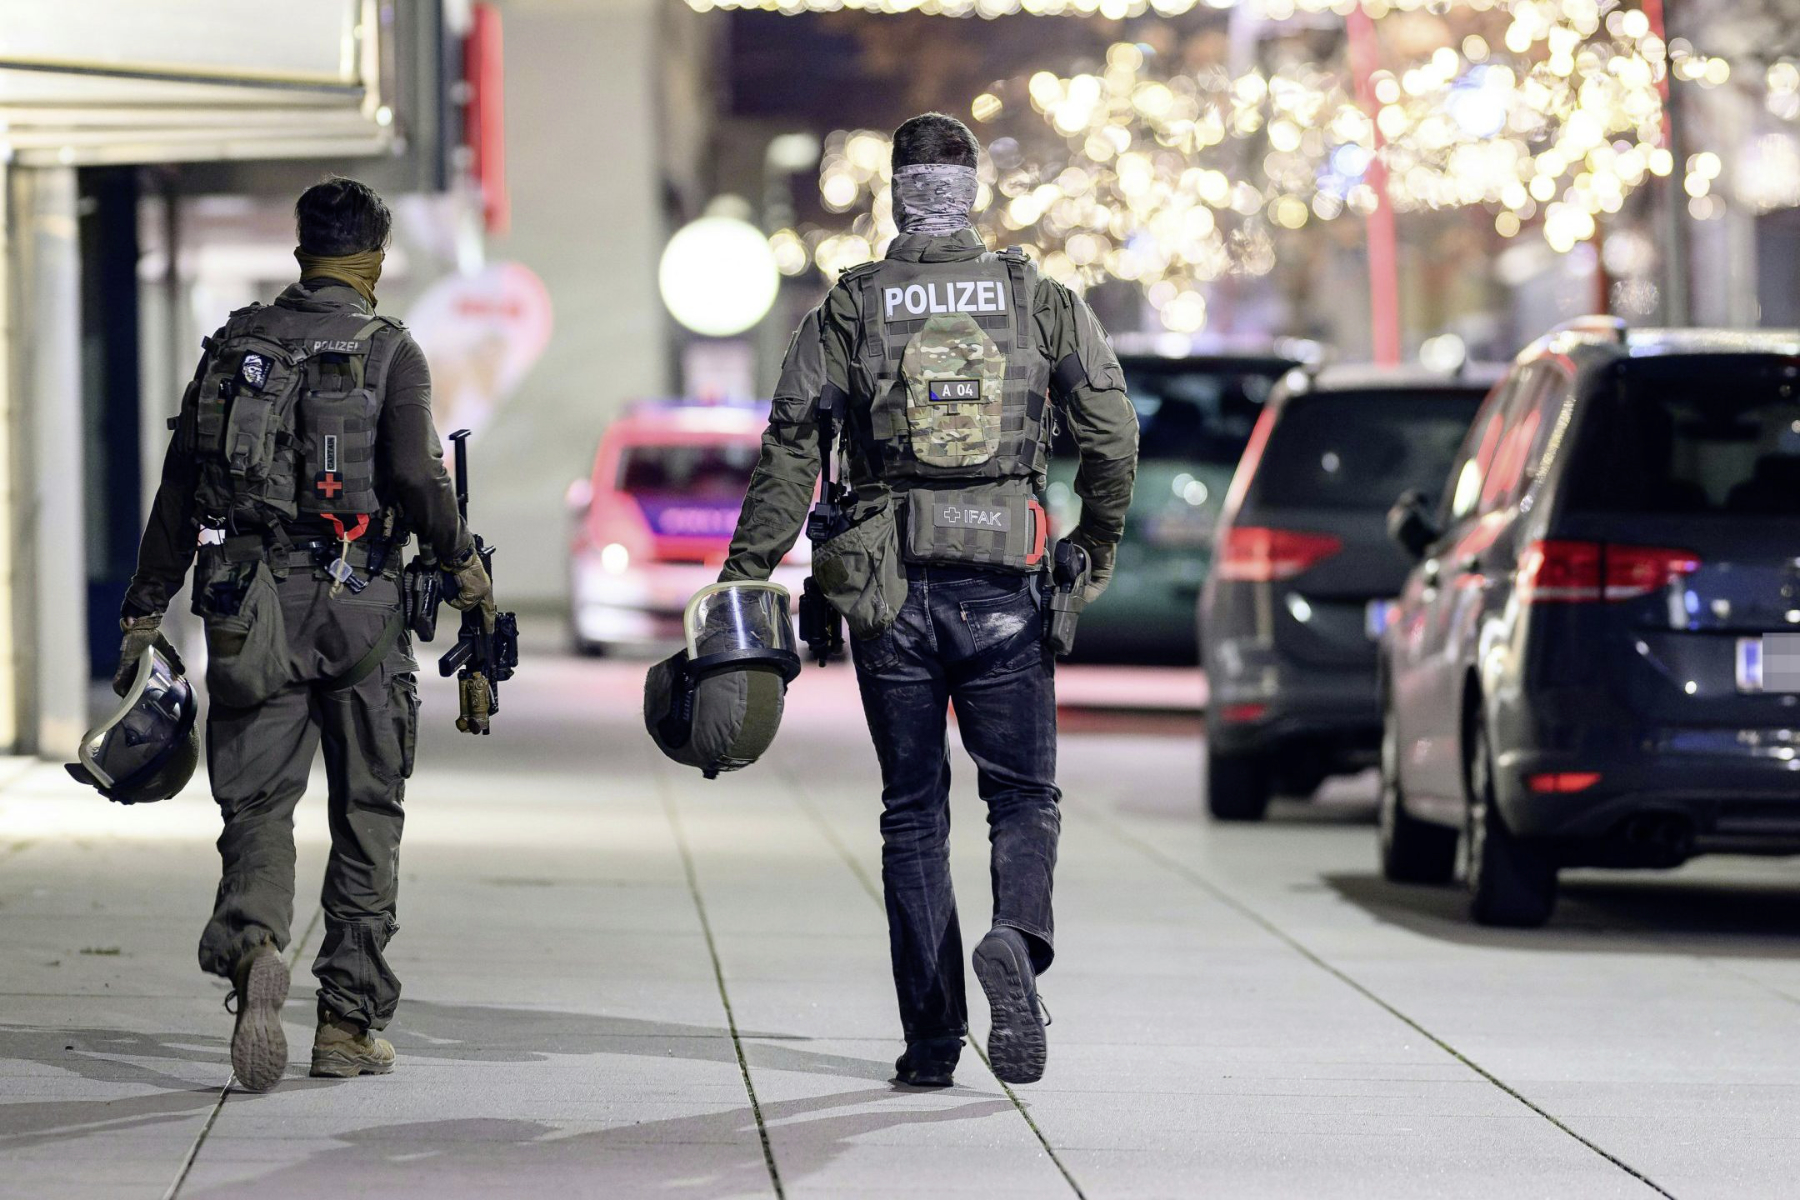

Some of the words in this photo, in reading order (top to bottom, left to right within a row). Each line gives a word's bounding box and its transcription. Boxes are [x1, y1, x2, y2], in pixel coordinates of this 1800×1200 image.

[884, 281, 1006, 317] POLIZEI
[313, 340, 359, 353] POLIZEI
[942, 384, 951, 397] A
[957, 383, 974, 396] 04
[964, 509, 1002, 527] IFAK
